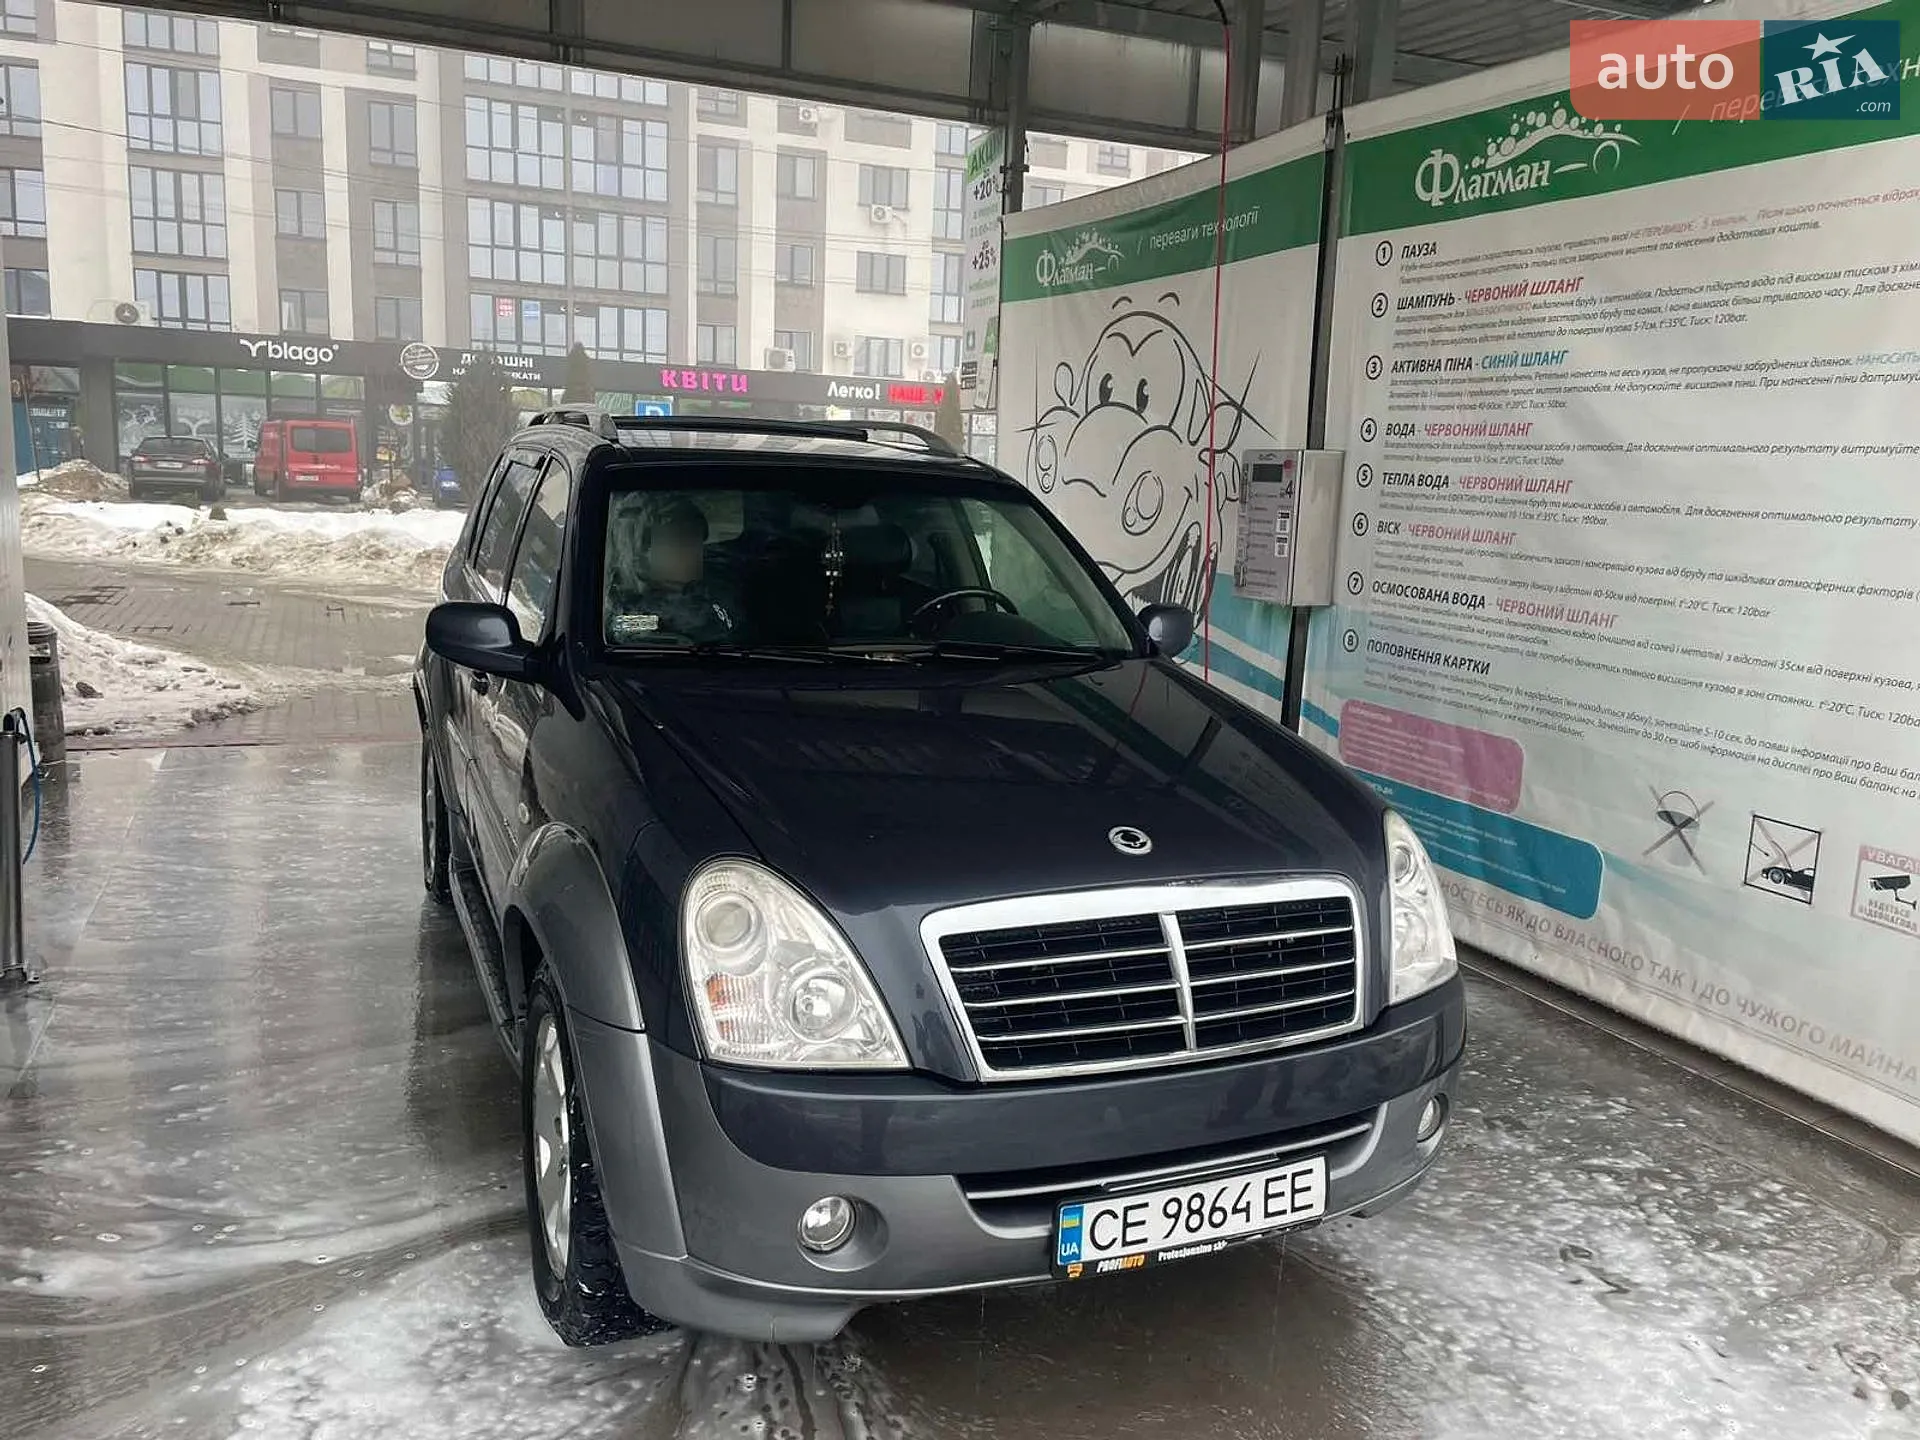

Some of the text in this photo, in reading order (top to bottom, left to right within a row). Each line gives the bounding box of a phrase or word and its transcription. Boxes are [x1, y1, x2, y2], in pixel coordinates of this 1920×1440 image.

[1415, 148, 1552, 207] Флагман
[1149, 225, 1200, 250] переваги
[1401, 240, 1437, 259] ПАУЗА
[1795, 270, 1841, 283] високим
[1842, 265, 1890, 278] тиском
[1396, 290, 1456, 310] ШАМПУНЬ
[1464, 278, 1529, 303] ЧЕРВОНИЙ
[1529, 276, 1584, 296] ШЛАНГ
[1852, 281, 1877, 295] Для
[1555, 326, 1567, 336] до
[461, 353, 533, 368] ДШНІ
[1390, 357, 1442, 374] АКТИВНА
[1443, 356, 1473, 371] ПІНА
[1481, 349, 1519, 368] СИНІЙ
[1520, 350, 1569, 366] ШЛАНГ
[1739, 358, 1810, 372] забруднених
[661, 369, 749, 393] КВІТИ
[827, 380, 881, 401] Легко!
[1614, 382, 1627, 391] Не
[1758, 375, 1780, 388] При
[1833, 372, 1861, 384] піни
[1385, 422, 1416, 438] ВОДА
[1423, 419, 1488, 437] ЧЕРВОНИЙ
[1487, 422, 1534, 436] ШЛАНГ
[1770, 444, 1838, 455] результату
[1839, 442, 1920, 456] витримуйте
[1381, 471, 1415, 486] ТЕПЛА
[1416, 473, 1450, 490] ВОДА
[1458, 472, 1524, 492] ЧЕРВОНИЙ
[1524, 478, 1574, 494] ШЛАНГ
[1760, 510, 1843, 523] оптимального
[1843, 514, 1918, 529] результату
[1376, 519, 1401, 535] ВІСК
[1407, 519, 1470, 542] ЧЕРВОНИЙ
[1471, 528, 1518, 546] ШЛАНГ
[1635, 564, 1665, 577] кузова
[1679, 567, 1707, 581] бруду
[1708, 571, 1723, 580] та
[1777, 575, 1856, 595] атмосферних
[1855, 582, 1914, 601] факторів
[1372, 579, 1449, 604] ОСМОСОВАНА
[1450, 590, 1486, 612] ВОДА
[1495, 594, 1565, 621] ЧЕРВОНИЙ
[1566, 607, 1619, 629] ШЛАНГ
[1366, 638, 1441, 666] ПОПОВНЕННЯ
[1442, 652, 1491, 676] КАРТКИ
[1778, 659, 1805, 673] 35см
[1805, 663, 1823, 676] від
[1823, 665, 1872, 685] поверхні
[1873, 675, 1914, 692] кузова,
[1679, 736, 1701, 751] щоб
[1757, 755, 1770, 765] на
[1812, 767, 1832, 781] про
[1833, 769, 1858, 785] Ваш
[1859, 775, 1899, 794] баланс
[1743, 734, 1758, 746] до
[1849, 758, 1871, 772] про
[1872, 760, 1899, 776] Ваш
[1506, 904, 1525, 924] ЯК
[1526, 915, 1550, 934] ДО
[1555, 924, 1644, 972] ВЛАСНОГО
[1650, 960, 1687, 989] ТАК
[1700, 984, 1730, 1006] ДО
[1736, 998, 1827, 1045] ЧУЖОГО
[1828, 1034, 1919, 1083] МАЙНА
[1089, 1168, 1314, 1251] CE 9864 EE
[1061, 1243, 1079, 1257] UA
[1096, 1254, 1145, 1273] PROFIAUTO
